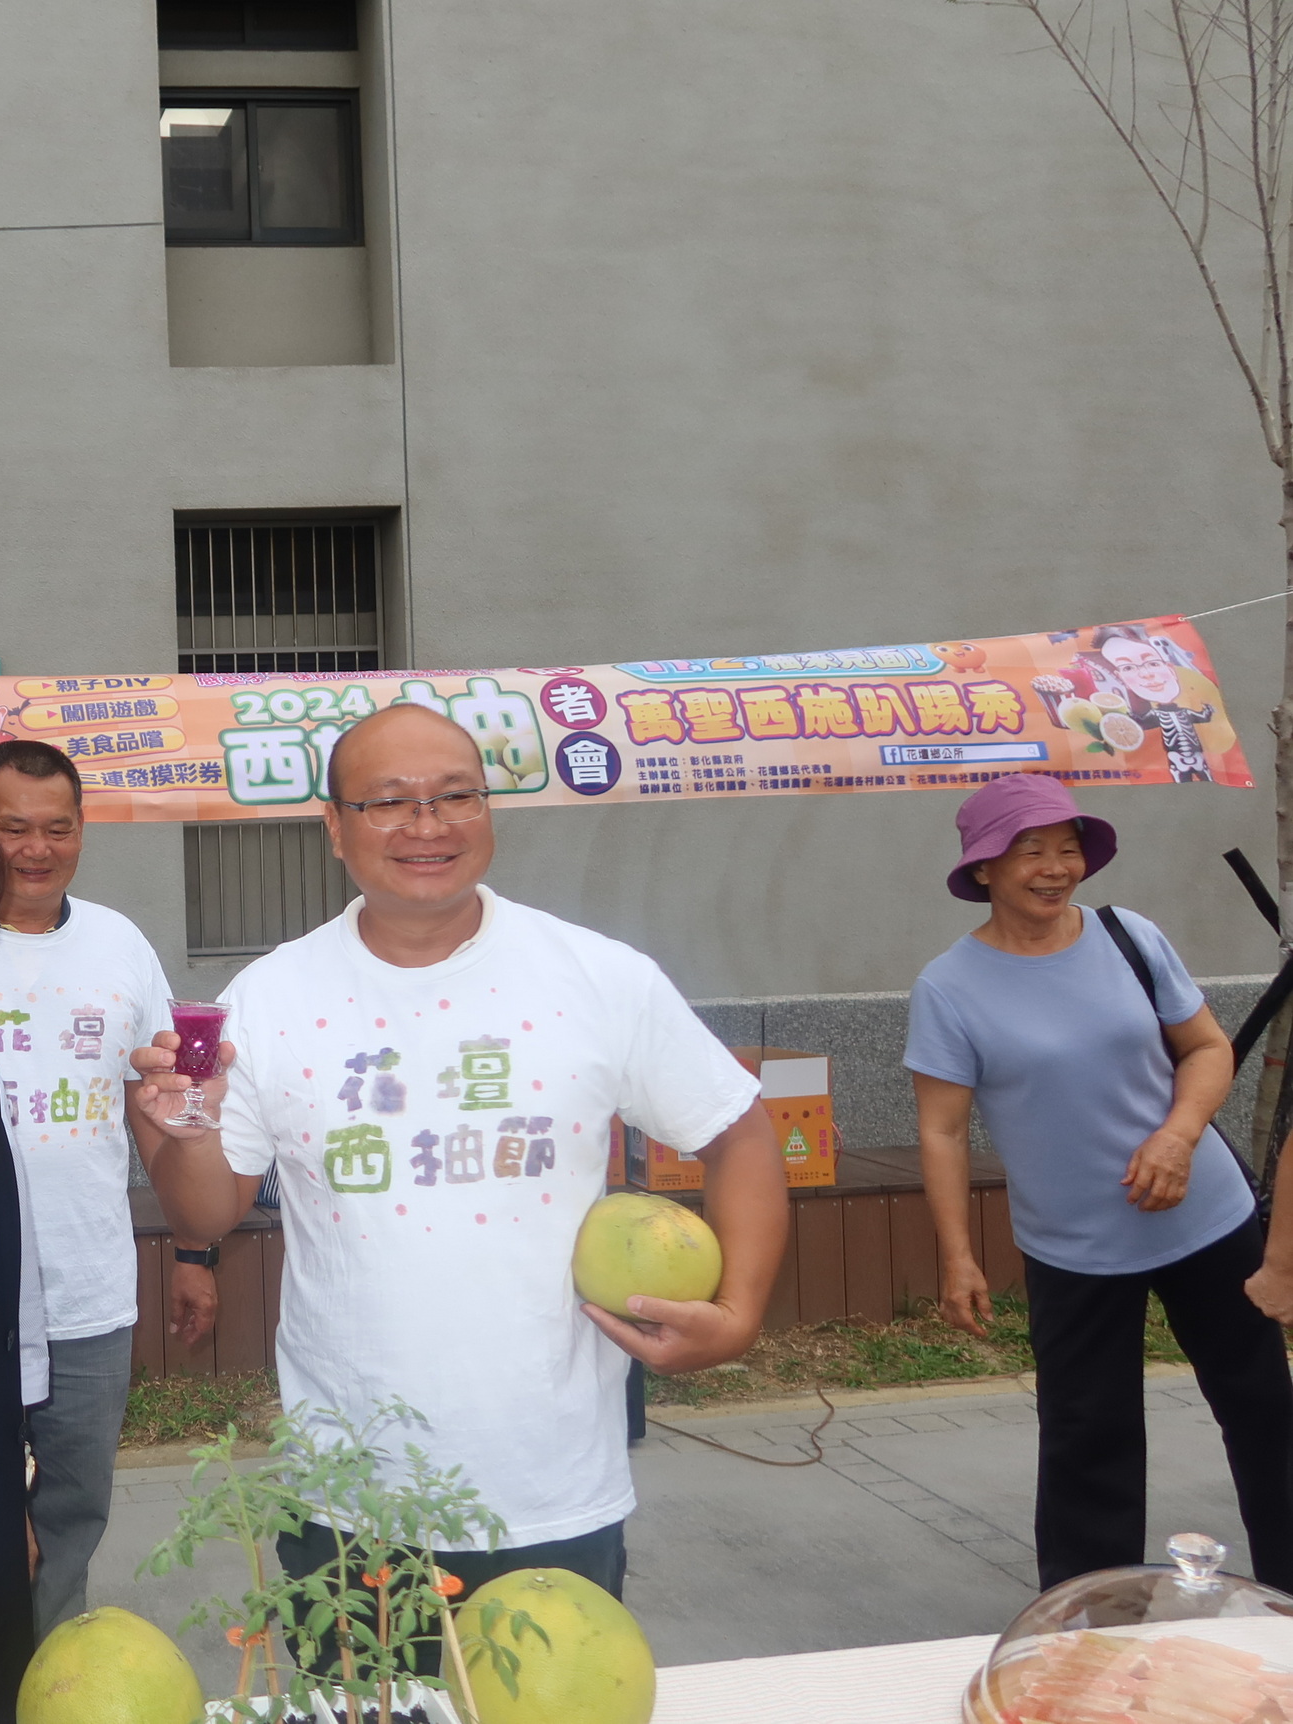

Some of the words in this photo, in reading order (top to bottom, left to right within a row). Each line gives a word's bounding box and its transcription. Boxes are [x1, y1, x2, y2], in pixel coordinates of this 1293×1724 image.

[55, 677, 151, 692] 親子DIY
[60, 699, 158, 723] 闖關遊戲
[231, 685, 376, 725] 2024
[617, 680, 1025, 745] 萬聖西施趴踢秀
[66, 730, 165, 758] 美食品嚐
[906, 747, 964, 760] 花壇鄉公所
[337, 1034, 513, 1116] 花壇
